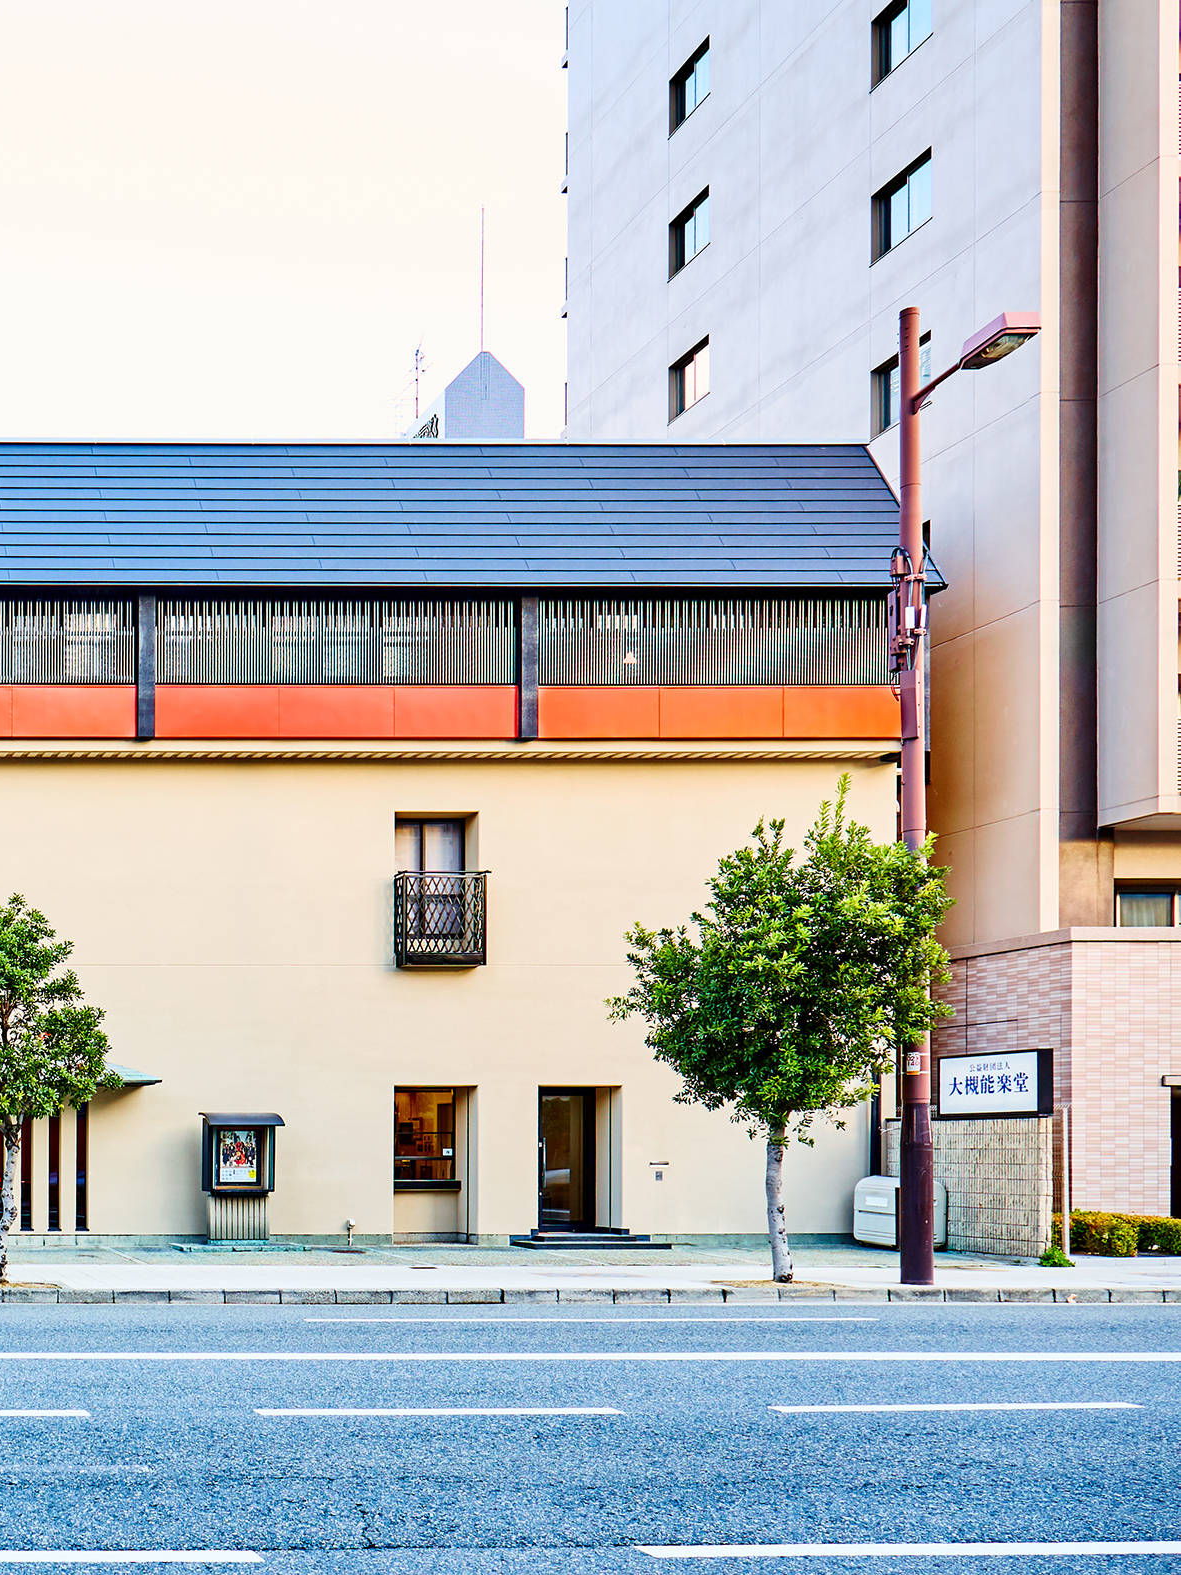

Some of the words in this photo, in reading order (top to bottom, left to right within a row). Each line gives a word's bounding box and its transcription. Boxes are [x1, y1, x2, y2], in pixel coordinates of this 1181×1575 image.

[969, 1061, 1011, 1073] 公益財団法人
[948, 1072, 1029, 1096] 大槻能楽堂
